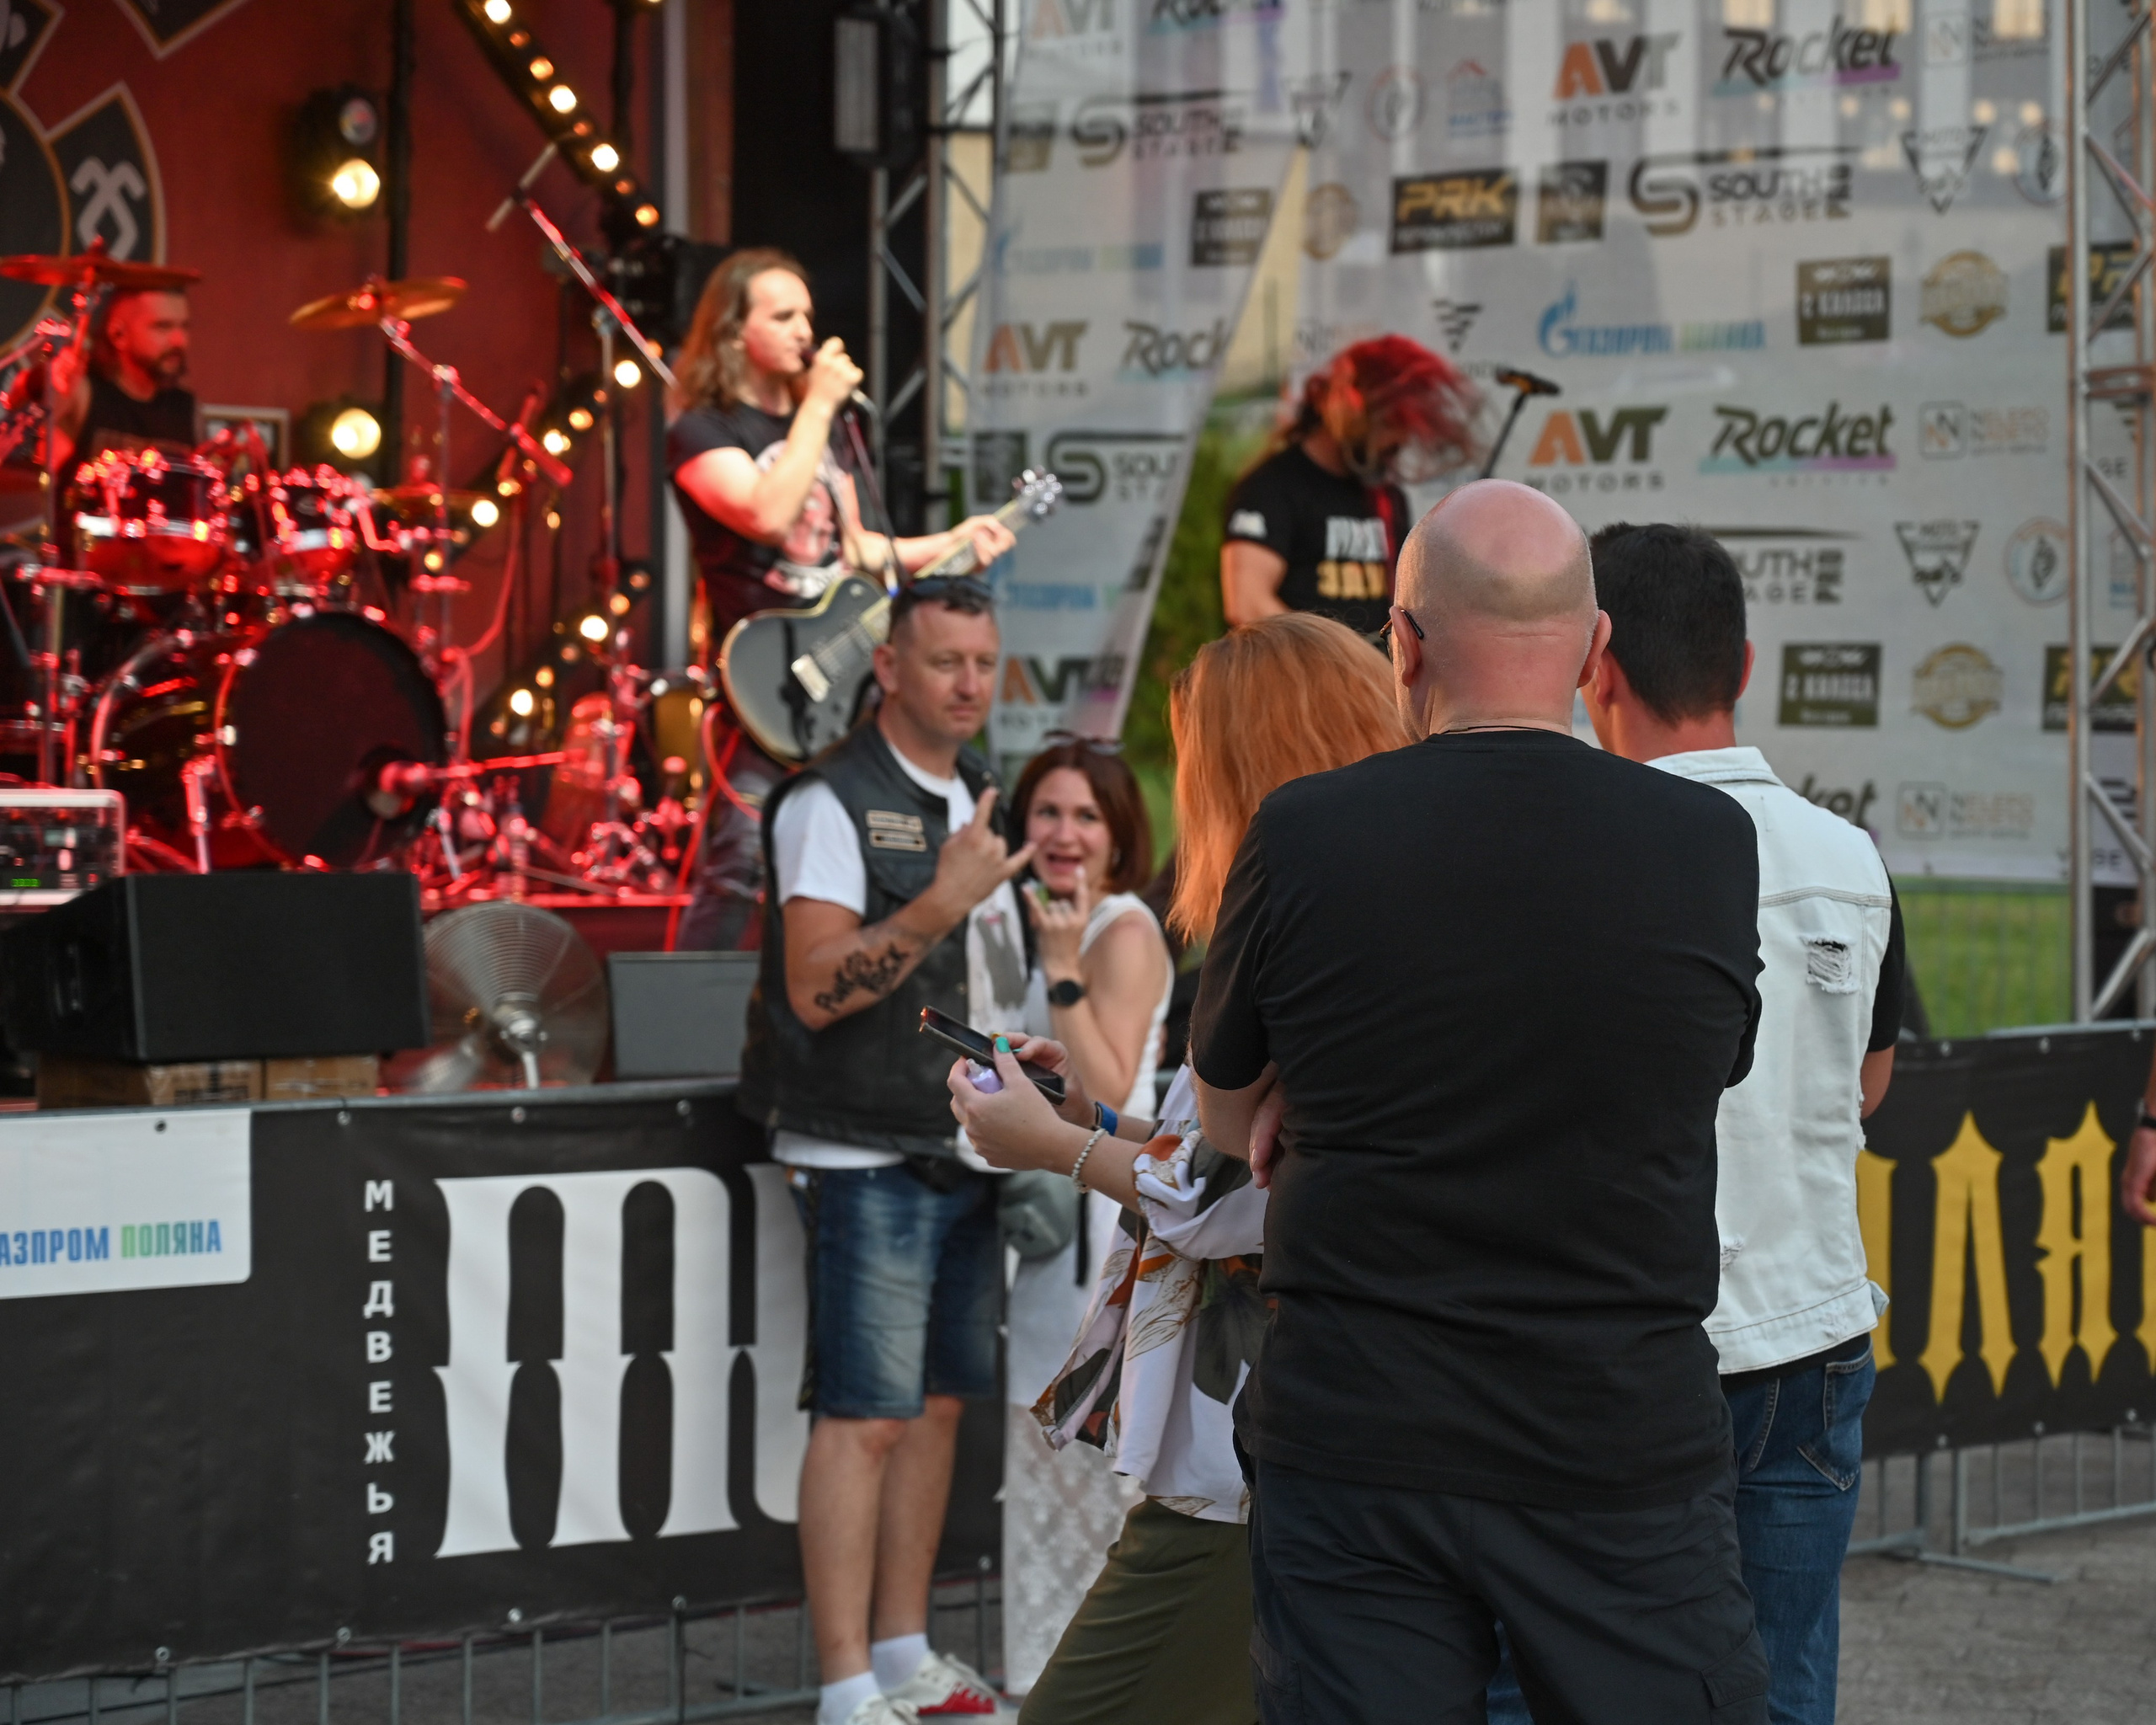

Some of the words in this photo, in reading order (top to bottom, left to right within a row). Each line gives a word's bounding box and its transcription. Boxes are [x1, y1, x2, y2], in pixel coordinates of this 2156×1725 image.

[1552, 32, 1681, 100] AVT
[1721, 14, 1897, 86] Rocket
[983, 319, 1088, 373] AVT
[1528, 406, 1668, 467] AVT
[1713, 399, 1896, 467] Rocket
[1525, 470, 1665, 494] MOTORS
[1735, 548, 1813, 579] UTH
[120, 1219, 222, 1258] ПОЛЯНА
[363, 1179, 394, 1564] МЕДВЕЖЬЯ
